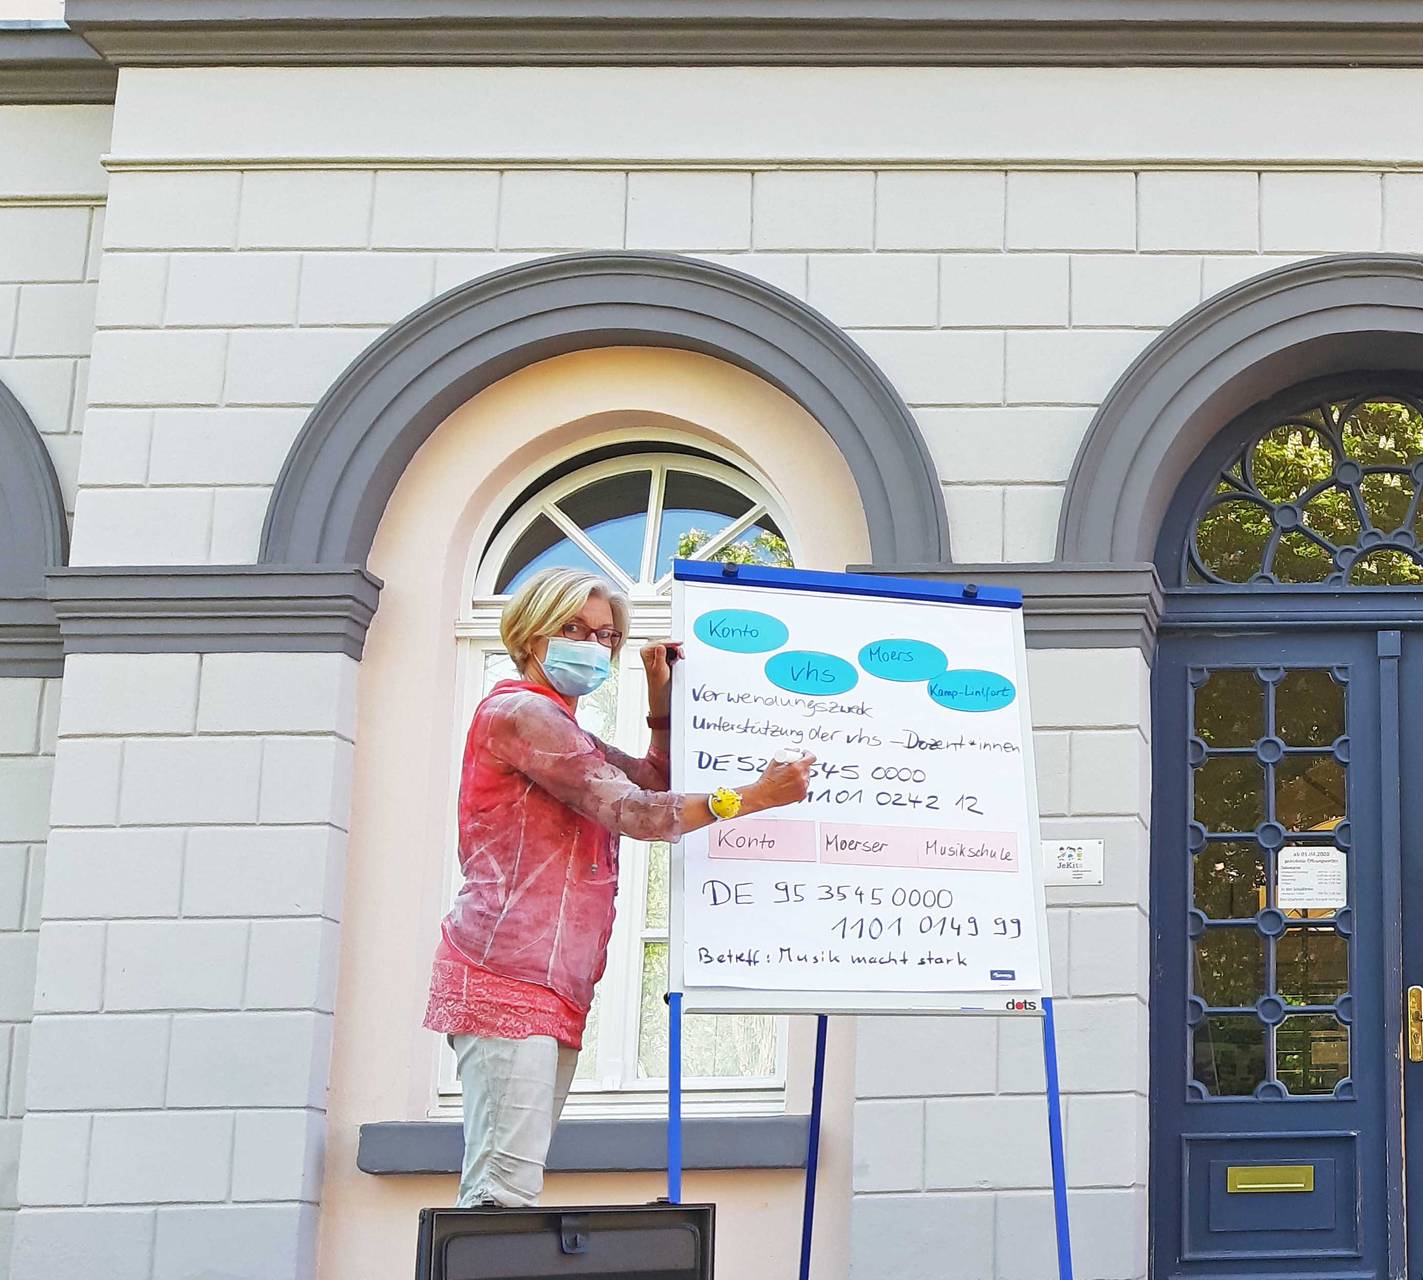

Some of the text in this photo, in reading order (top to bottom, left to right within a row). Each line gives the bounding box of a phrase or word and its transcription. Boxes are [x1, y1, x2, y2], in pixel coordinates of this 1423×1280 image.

[709, 619, 759, 638] Konto
[869, 646, 914, 662] Moers
[791, 662, 836, 683] vhs
[692, 684, 873, 718] Verwendungszweck
[693, 715, 803, 743] Unterstützung
[809, 726, 841, 742] der
[846, 728, 882, 747] vhs
[871, 766, 926, 782] 0000
[876, 792, 940, 810] 0242
[955, 793, 983, 815] 12
[717, 827, 1013, 861] Konto Moerser Musikschule
[702, 880, 755, 906] DE
[773, 881, 805, 904] 95
[831, 916, 902, 939] 1101
[919, 916, 980, 937] 0149
[779, 947, 840, 964] Musik
[851, 948, 908, 966] macht
[918, 949, 967, 967] stark
[1005, 998, 1037, 1010] dots
